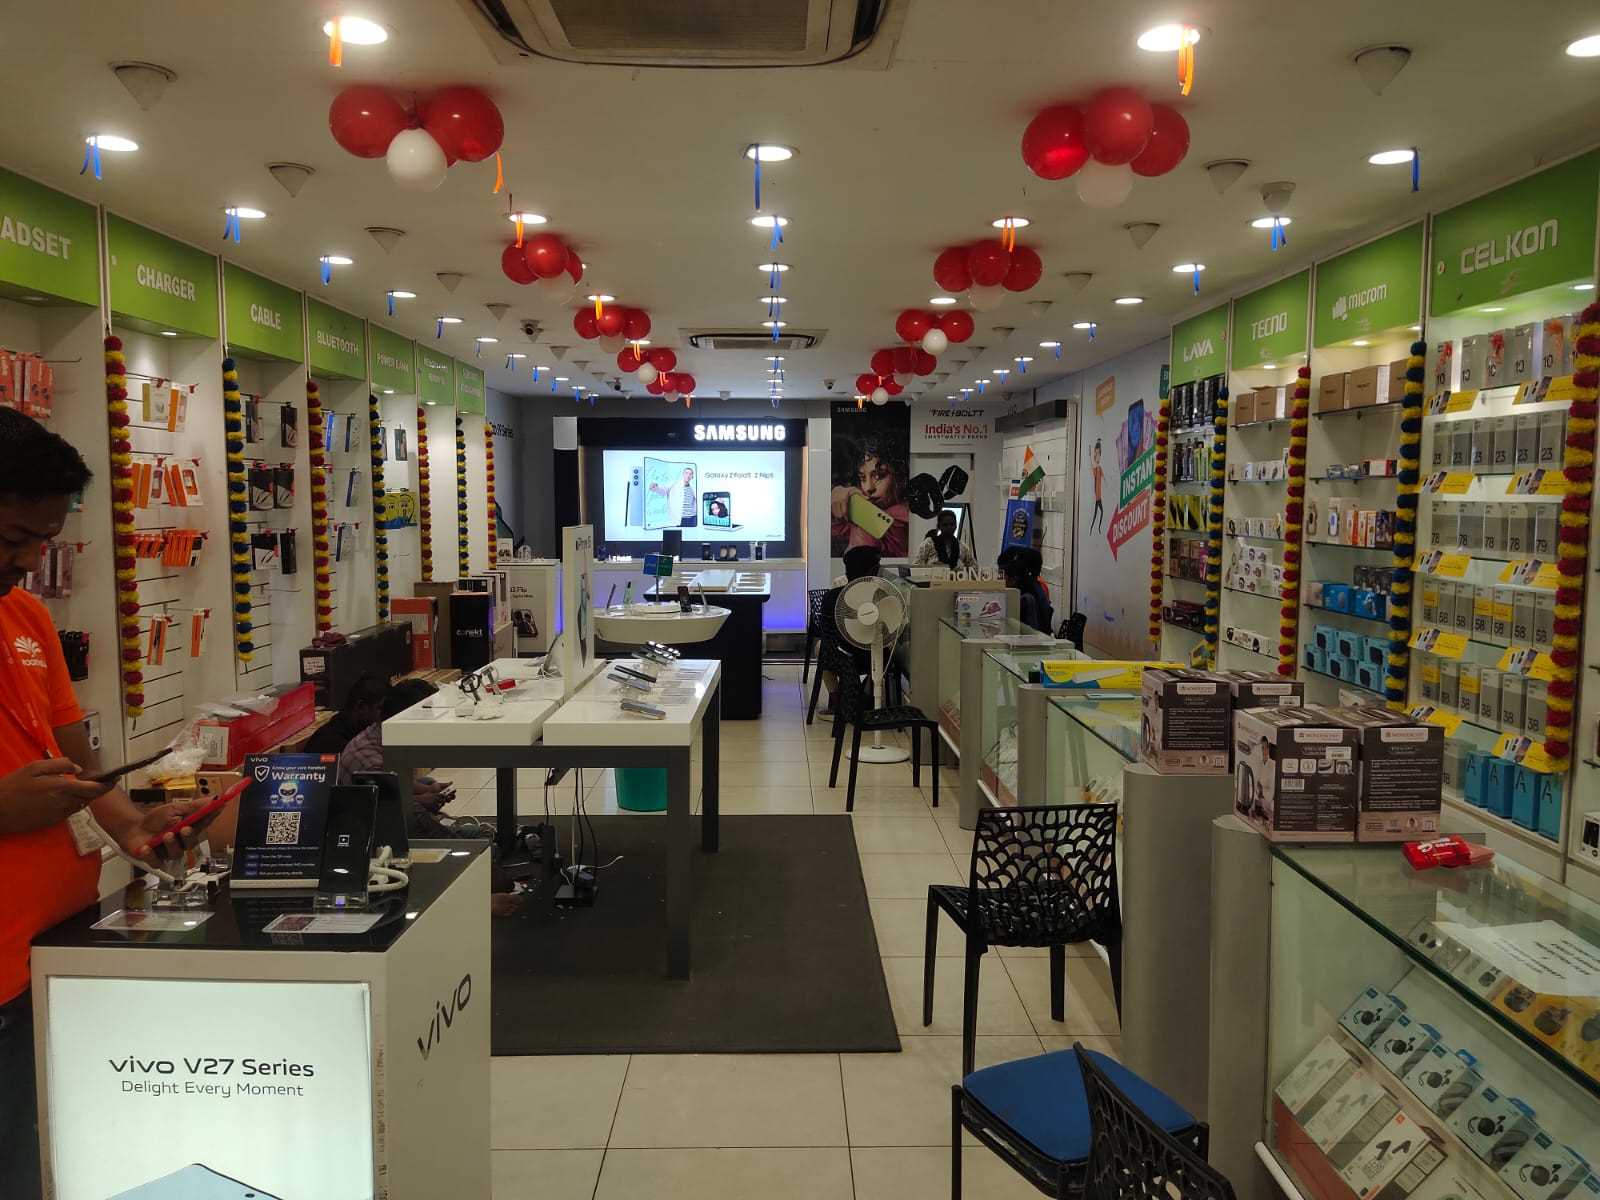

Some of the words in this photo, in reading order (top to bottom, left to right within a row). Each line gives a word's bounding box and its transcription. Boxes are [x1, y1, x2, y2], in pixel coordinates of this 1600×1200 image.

[0, 214, 72, 260] ADSET
[1460, 218, 1559, 274] CELKON
[136, 263, 196, 301] CHARGER
[250, 303, 282, 330] CABLE
[1251, 311, 1287, 341] TECNO
[316, 330, 360, 356] BLUETOOTH
[1183, 338, 1214, 362] LAVA
[1543, 353, 1554, 368] 10
[1436, 373, 1446, 385] 10
[693, 424, 787, 441] SAMSUNG
[924, 422, 960, 434] India's
[963, 423, 989, 434] No.1
[1518, 449, 1528, 462] 23
[1541, 447, 1552, 461] 23
[1121, 454, 1156, 499] INSTAN
[1112, 503, 1148, 544] DISCOUNT
[1458, 534, 1468, 546] 78
[1485, 536, 1495, 549] 78
[1509, 537, 1520, 550] 78
[1456, 615, 1466, 627] 58
[1474, 620, 1485, 632] 58
[1494, 623, 1504, 635] 58
[1503, 709, 1514, 723] 38
[1466, 753, 1477, 776] A
[1489, 763, 1499, 785] A
[271, 771, 327, 783] Warranty
[1515, 768, 1527, 793] A
[1541, 779, 1553, 804] A
[417, 974, 471, 1061] vivo
[109, 1056, 175, 1075] vivo
[183, 1057, 235, 1075] V27
[242, 1058, 315, 1077] Series
[121, 1080, 180, 1096] Delight
[185, 1082, 232, 1098] Every
[236, 1083, 304, 1097] Moment
